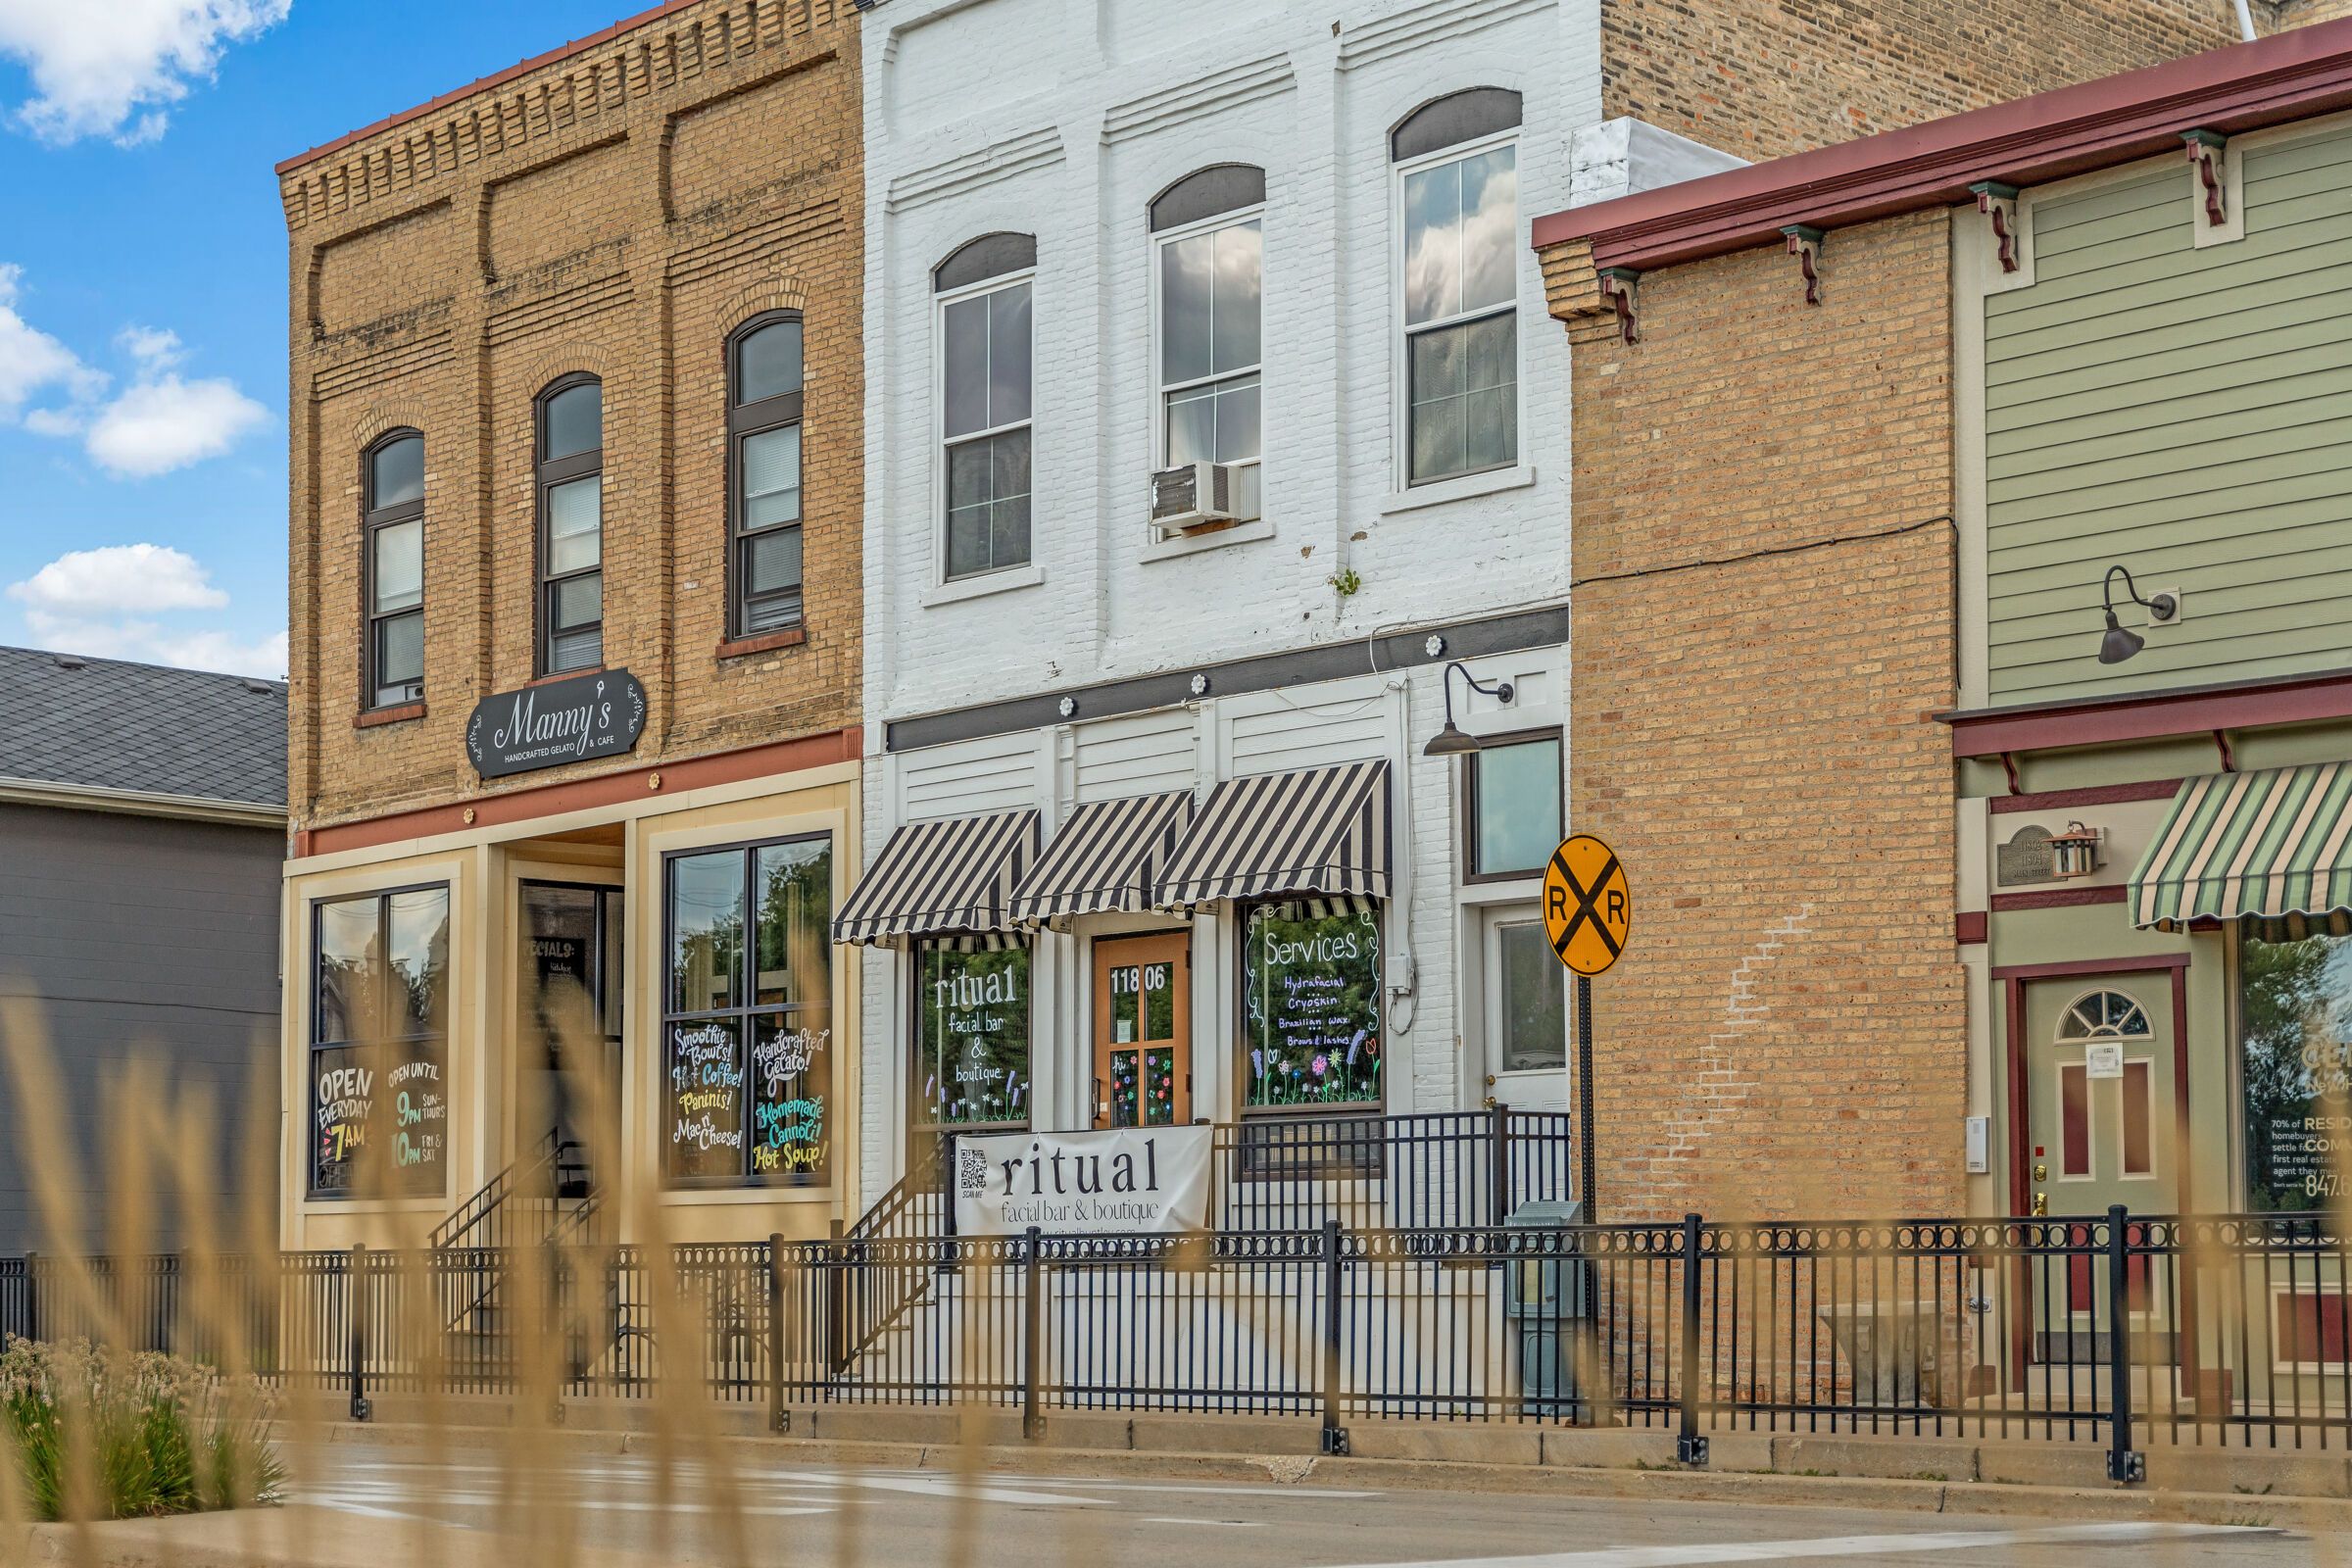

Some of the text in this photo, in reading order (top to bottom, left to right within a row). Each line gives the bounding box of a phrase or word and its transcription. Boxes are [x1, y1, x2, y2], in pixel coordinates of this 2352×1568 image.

[494, 680, 612, 756] Manny's
[505, 735, 614, 763] HANDCRAFTED GELATO & CAFE
[530, 940, 575, 958] ECIALS:
[1265, 932, 1357, 965] Services
[935, 964, 1017, 1008] ritual
[1285, 976, 1344, 995] Hydrafacial
[1289, 998, 1338, 1011] Cryoskin
[949, 1010, 1004, 1032] facial bar
[1279, 1017, 1322, 1028] Brazilian
[674, 1024, 726, 1056] Smoothie
[754, 1028, 830, 1066] Handcrafted
[971, 1036, 987, 1058] &
[1288, 1036, 1312, 1046] Brows
[1323, 1036, 1349, 1045] lashes
[686, 1044, 733, 1067] Bowls!
[1112, 1055, 1126, 1073] hi
[389, 1061, 439, 1088] OPEN UNTIL
[672, 1062, 743, 1092] Hot Coffee!
[956, 1063, 1003, 1085] boutique
[318, 1067, 373, 1105] OPEN
[422, 1105, 445, 1119] THURS
[679, 1090, 732, 1114] Paninis!
[756, 1095, 824, 1128] Homemade
[318, 1100, 372, 1130] EVERYDAY
[2272, 1119, 2301, 1128] 70% of
[2304, 1117, 2352, 1130] RESID
[421, 1134, 442, 1148] FRI &
[673, 1119, 701, 1144] Mac
[699, 1125, 743, 1151] Cheese!
[768, 1119, 822, 1149] Cannoli!
[2272, 1131, 2323, 1141] homebuyers
[422, 1150, 435, 1161] SAT
[754, 1141, 828, 1171] Hot Soup!
[2273, 1154, 2290, 1163] first
[2292, 1154, 2308, 1163] real
[1002, 1138, 1159, 1197] ritual
[2274, 1168, 2296, 1177] agent
[1002, 1199, 1159, 1225] facial bar & boutique
